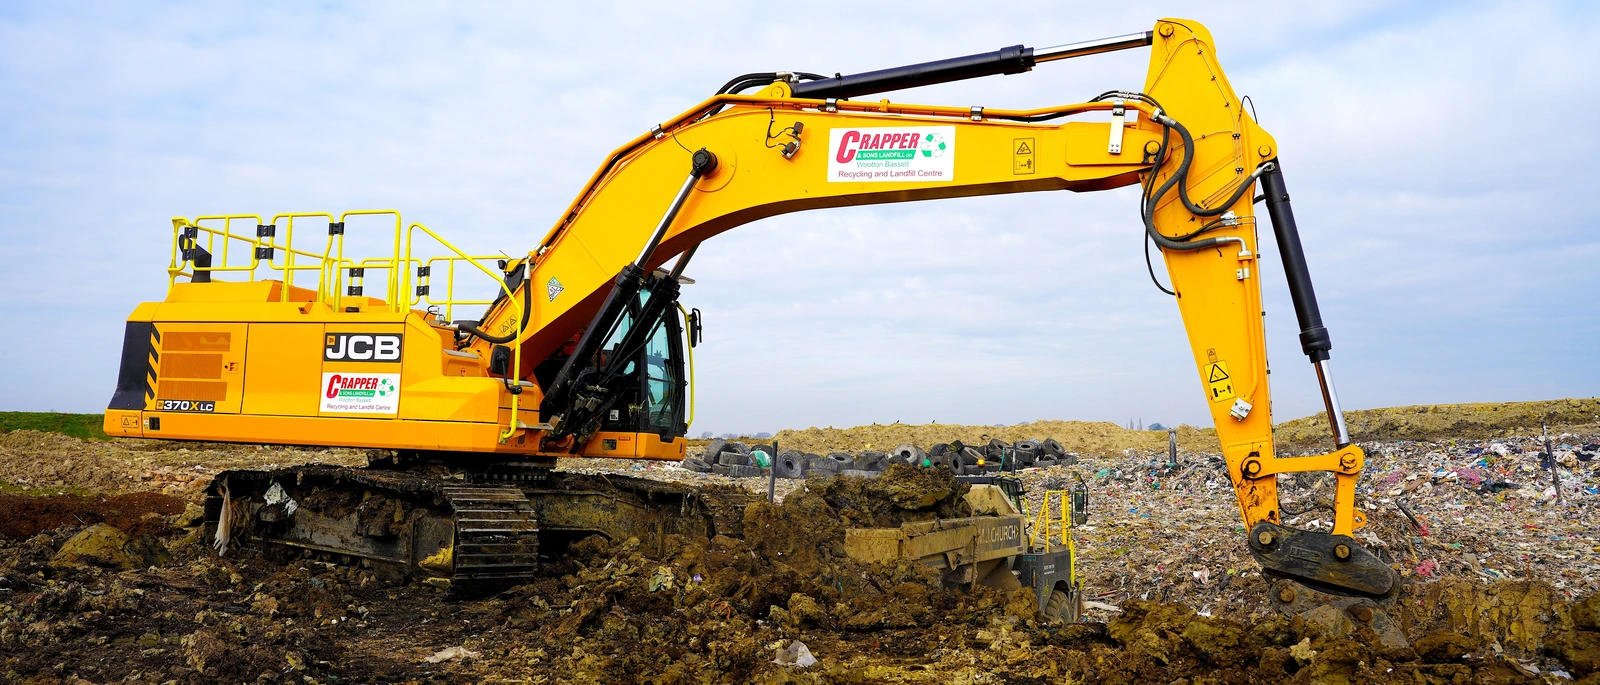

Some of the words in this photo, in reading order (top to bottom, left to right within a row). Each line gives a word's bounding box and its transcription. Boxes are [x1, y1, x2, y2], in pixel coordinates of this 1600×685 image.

[836, 130, 920, 164] CRAPPER
[885, 160, 910, 168] Bassett
[838, 170, 873, 179] Recycling
[918, 169, 943, 177] Centre
[326, 335, 400, 360] JCB
[326, 374, 379, 399] CRAPPER
[200, 403, 214, 411] LC
[326, 403, 348, 411] Recycling
